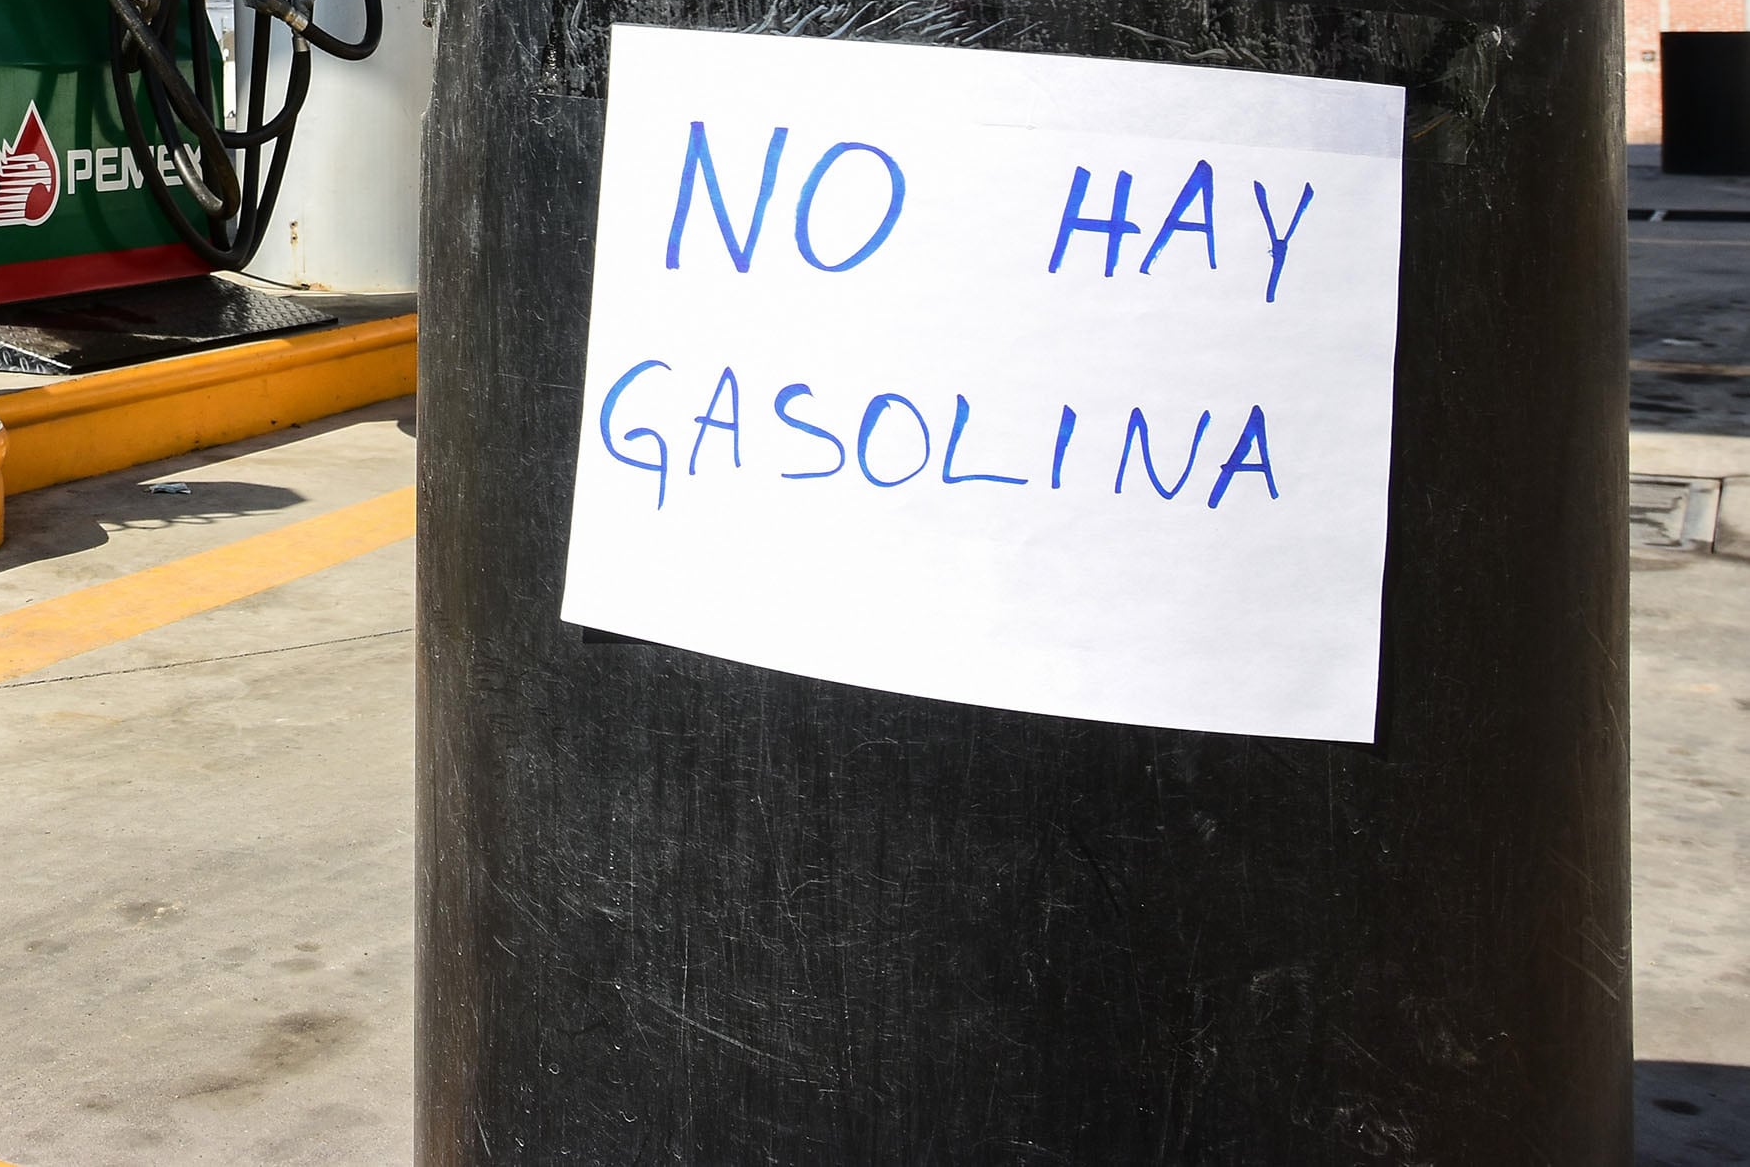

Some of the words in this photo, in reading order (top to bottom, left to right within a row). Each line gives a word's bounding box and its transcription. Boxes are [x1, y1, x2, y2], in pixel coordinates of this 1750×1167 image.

[665, 121, 907, 273] NO
[1048, 159, 1314, 302] HAY
[600, 359, 1278, 510] GASOLINA
